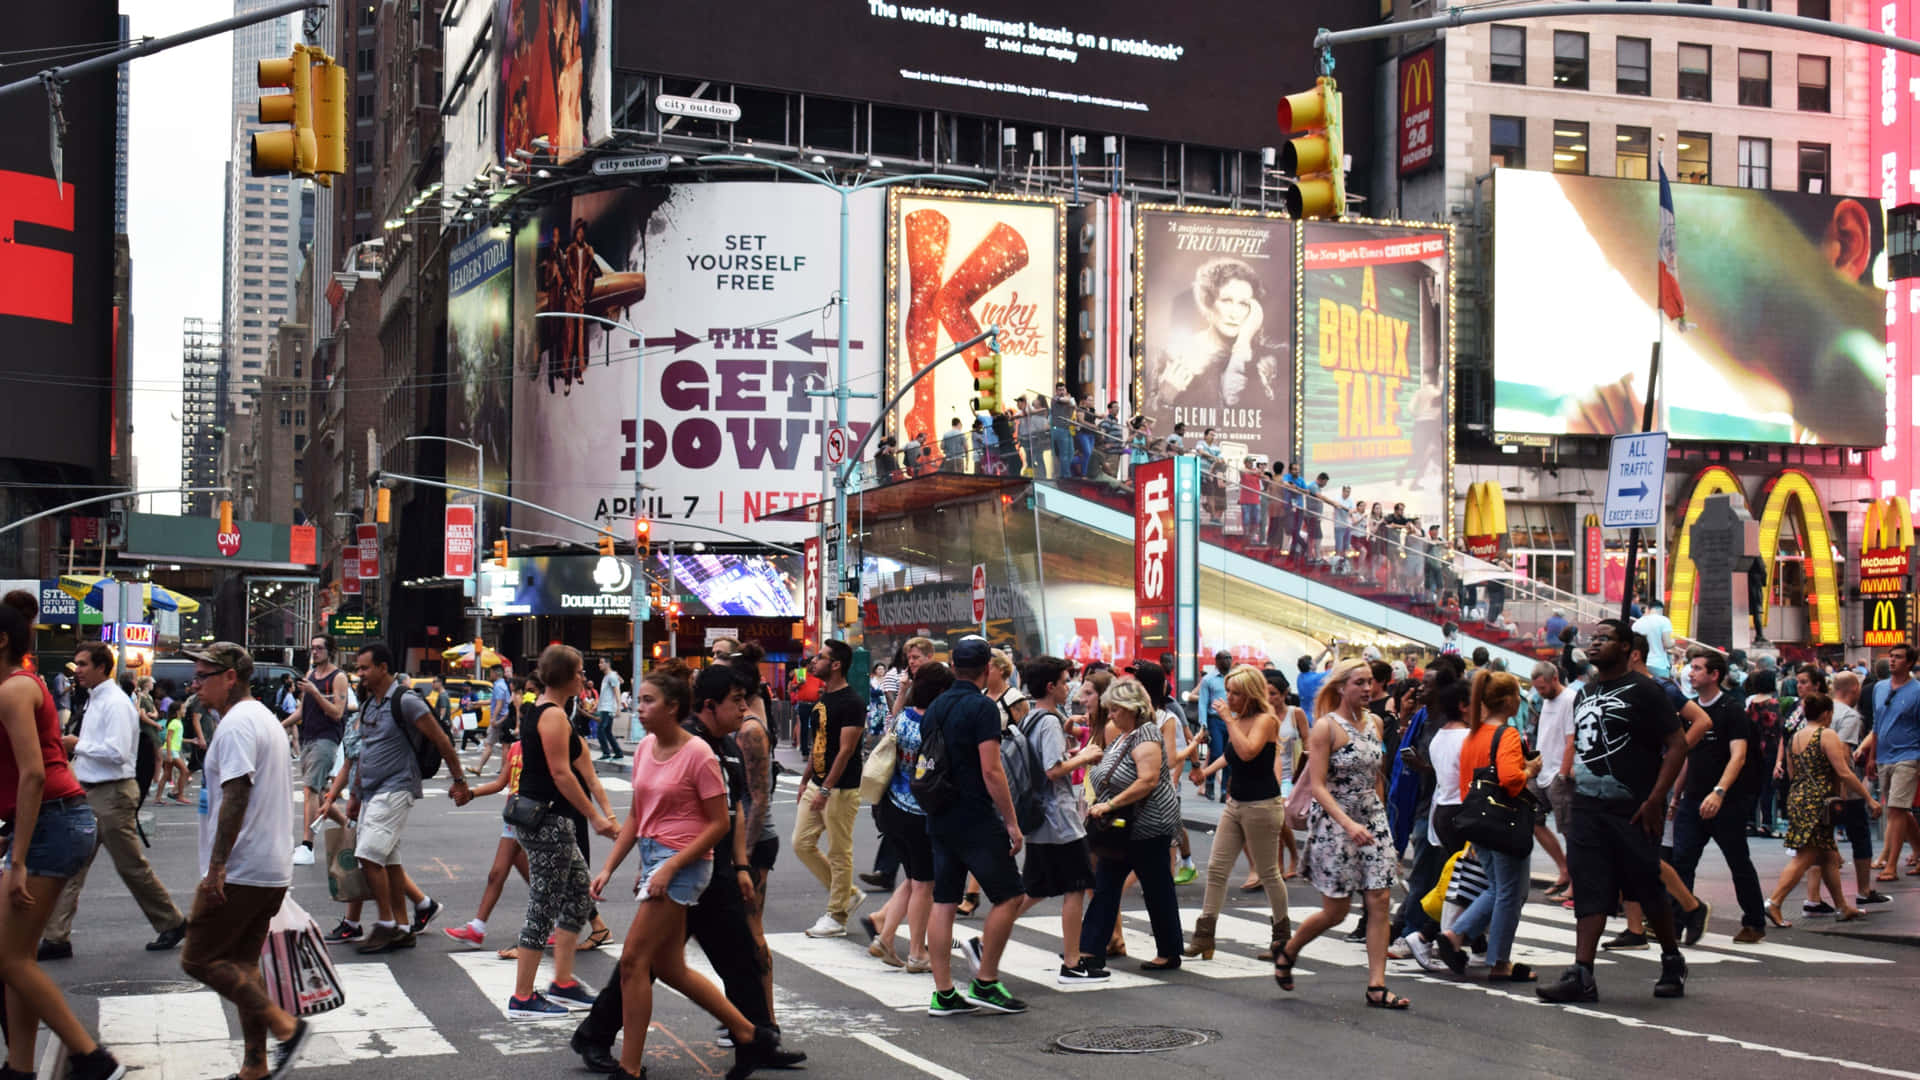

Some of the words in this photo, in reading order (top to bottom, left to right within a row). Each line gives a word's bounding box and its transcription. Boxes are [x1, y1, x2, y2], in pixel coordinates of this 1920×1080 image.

[868, 0, 897, 18] The
[900, 6, 957, 27] world's
[960, 13, 1026, 38] slimmest
[1028, 21, 1073, 45] bezels
[1076, 33, 1096, 48] on
[1098, 36, 1109, 50] a
[984, 36, 998, 49] 2K
[1000, 40, 1021, 53] vivid
[1022, 43, 1045, 56] color
[1046, 46, 1078, 63] display
[664, 99, 686, 112] city
[689, 102, 734, 116] outdoor
[1405, 108, 1430, 129] OPEN
[1407, 123, 1427, 150] 24
[600, 159, 619, 172] city
[622, 157, 664, 168] outdoor
[1402, 144, 1433, 168] HOURS
[1216, 226, 1270, 239] mesmerizing
[725, 234, 767, 251] SET
[686, 254, 807, 272] YOURSELF
[1304, 249, 1320, 261] The
[1320, 248, 1338, 261] New
[1338, 248, 1359, 263] York
[1359, 246, 1384, 259] Times
[450, 255, 482, 293] LEADERS
[483, 239, 508, 273] TODAY
[716, 274, 775, 290] FREE
[1361, 264, 1378, 311] A
[708, 328, 778, 350] THE
[1319, 297, 1411, 380] BRONX
[660, 359, 828, 413] GET
[1333, 369, 1404, 439] TALE
[1174, 406, 1217, 427] GLENN
[1223, 407, 1263, 428] CLOSE
[1628, 440, 1648, 457] ALL
[1620, 461, 1654, 477] TRAFFIC
[683, 496, 700, 518] 7
[1608, 510, 1633, 521] EXCEPT
[1634, 508, 1655, 520] BIKES
[217, 532, 241, 546] CNY
[1144, 472, 1169, 600] tkts
[1861, 555, 1907, 568] McDonald's
[42, 588, 73, 599] STE
[807, 543, 818, 627] tkts
[42, 605, 77, 615] GAME
[124, 627, 150, 641] ODA
